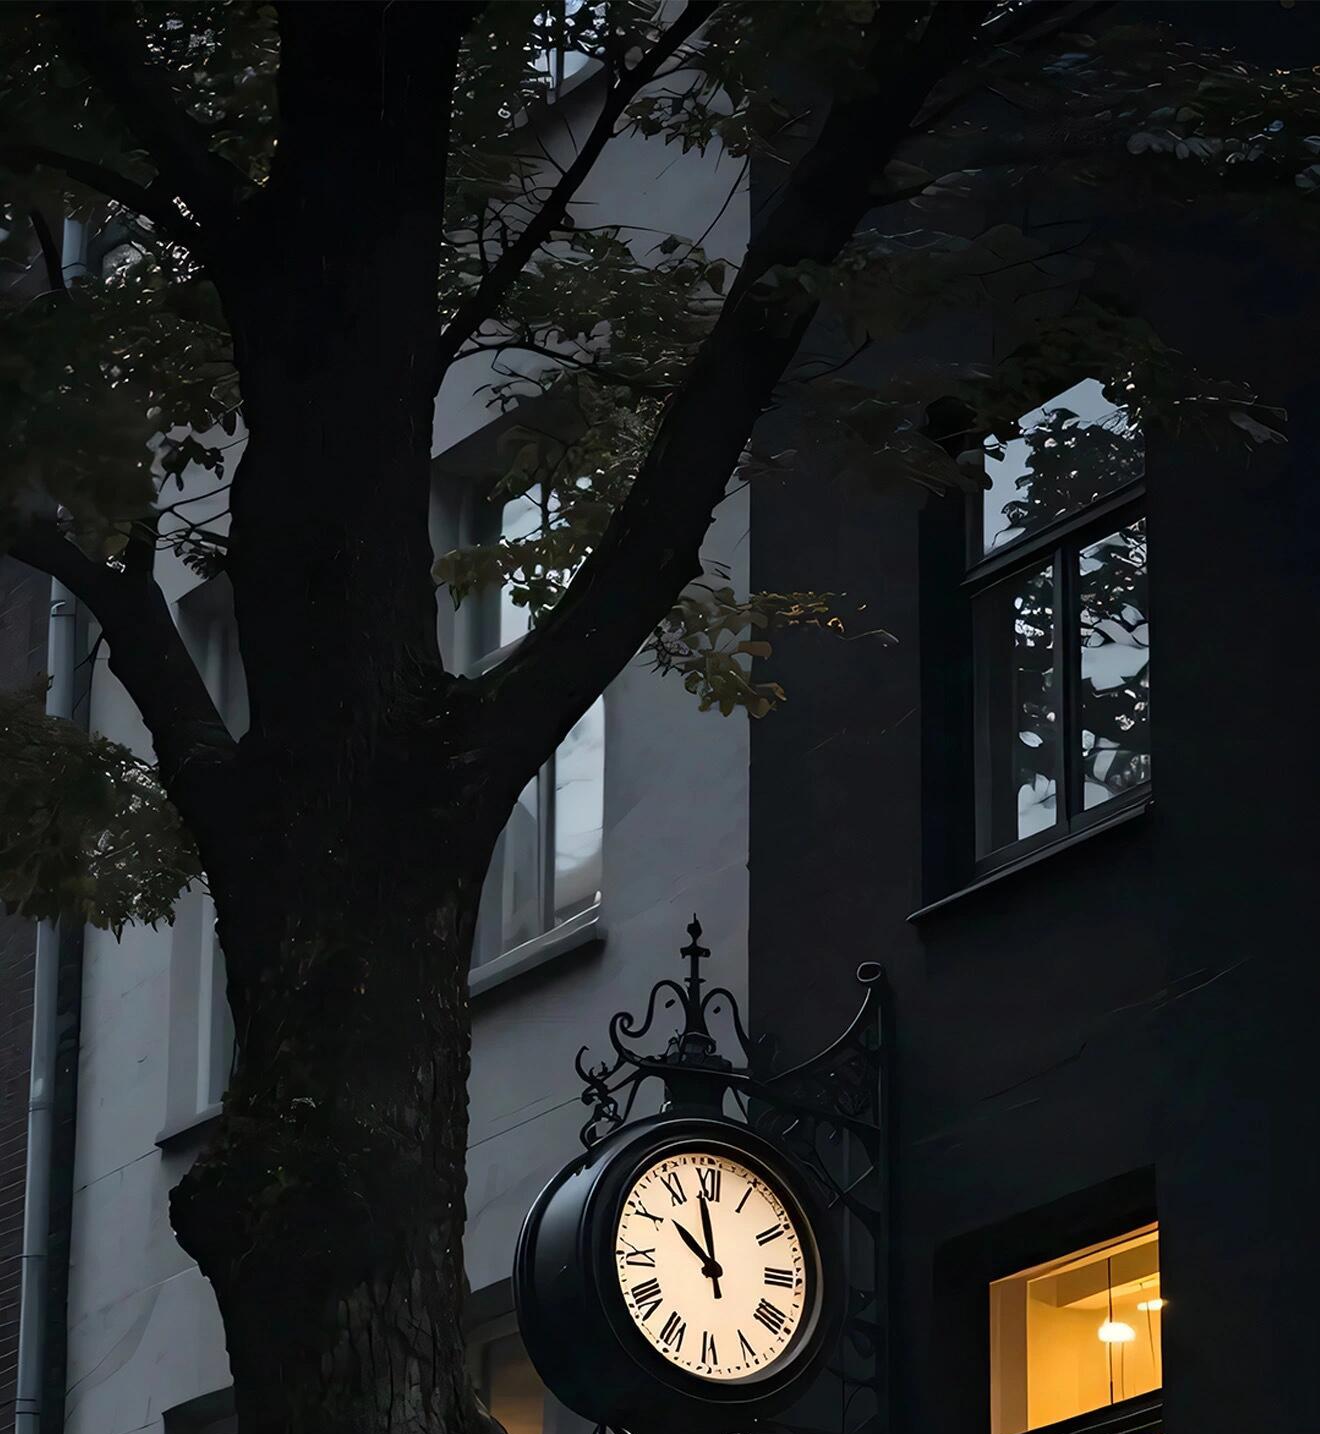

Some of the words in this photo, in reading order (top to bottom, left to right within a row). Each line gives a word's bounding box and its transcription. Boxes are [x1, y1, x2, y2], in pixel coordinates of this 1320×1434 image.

[634, 1201, 664, 1231] X
[755, 1223, 785, 1246] II
[620, 1237, 656, 1267] IX
[764, 1267, 793, 1289] III
[631, 1277, 663, 1321] VIII
[660, 1311, 686, 1352] VII
